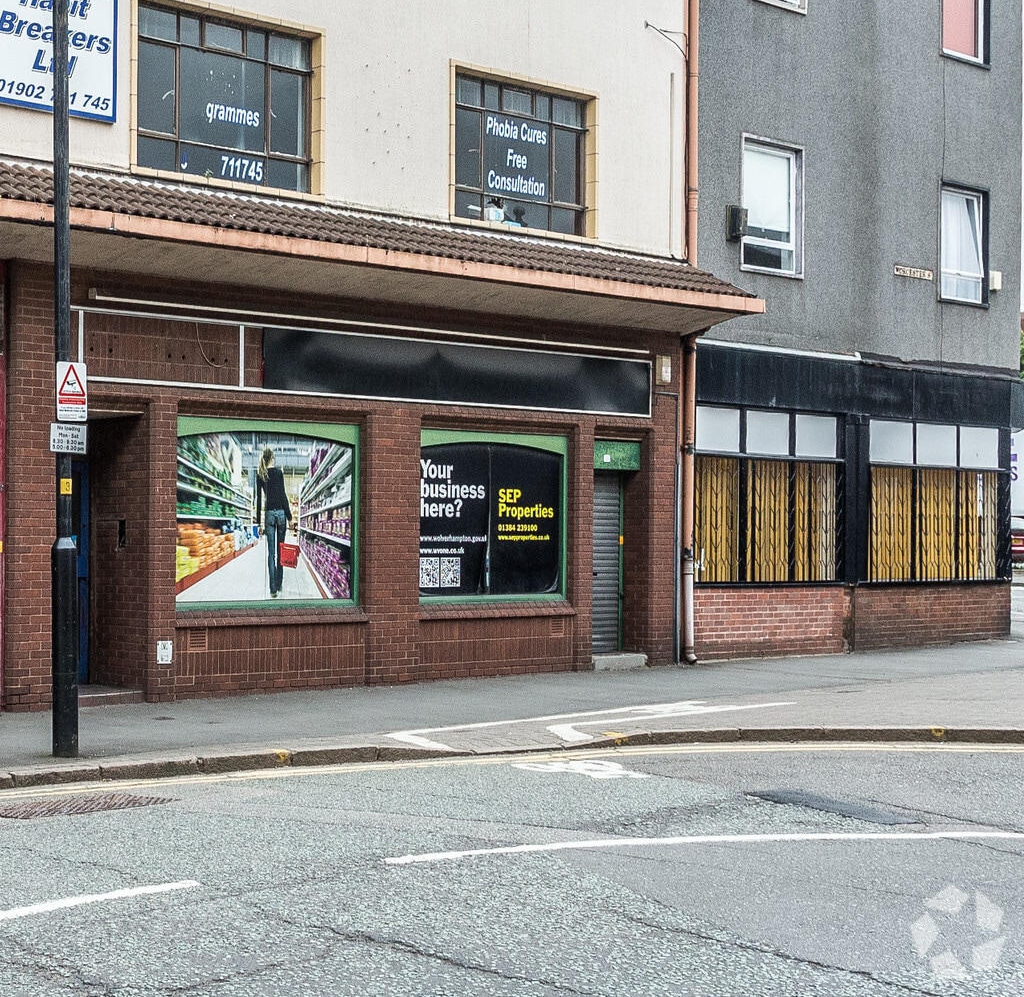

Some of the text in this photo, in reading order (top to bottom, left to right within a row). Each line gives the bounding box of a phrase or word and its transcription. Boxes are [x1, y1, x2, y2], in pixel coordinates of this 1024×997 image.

[83, 94, 110, 111] 745
[206, 102, 260, 127] grammes
[486, 116, 547, 145] Phobia Cures
[221, 155, 263, 181] 711745
[506, 149, 527, 169] Free
[488, 170, 545, 197] Consultation
[420, 459, 453, 479] Your
[65, 482, 71, 492] 3
[420, 479, 485, 498] business
[498, 489, 522, 503] SEP
[420, 498, 463, 517] here?
[498, 503, 554, 520] Properties
[498, 524, 538, 532] 01384 239100
